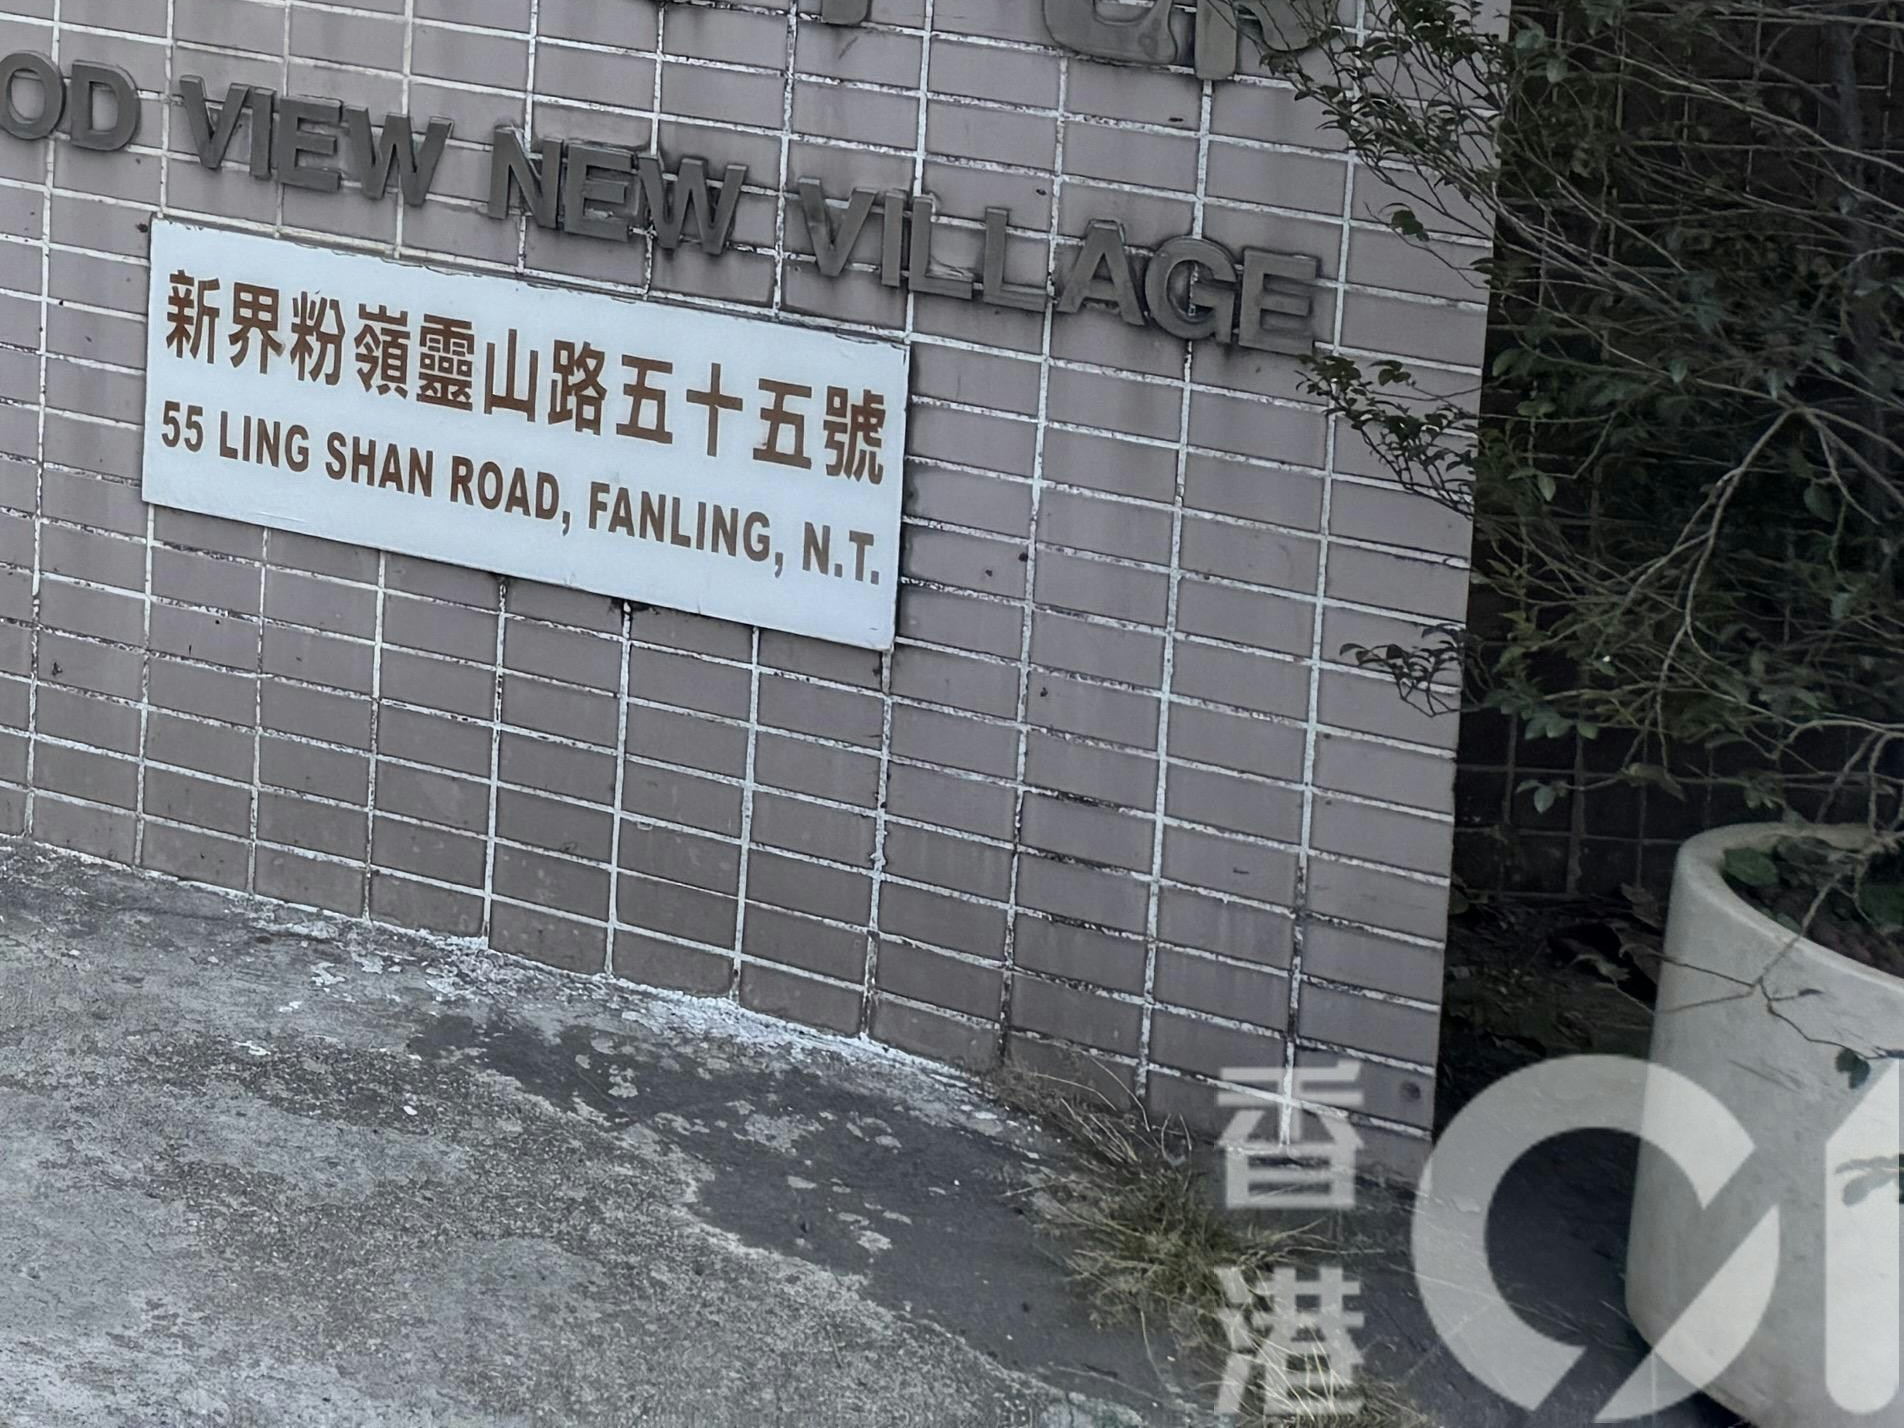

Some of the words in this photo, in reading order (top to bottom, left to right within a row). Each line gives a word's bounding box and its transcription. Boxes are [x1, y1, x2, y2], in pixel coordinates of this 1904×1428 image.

[180, 73, 454, 207] VIEW
[488, 122, 749, 256] NEW
[795, 176, 1323, 358] VILLAGE
[166, 269, 887, 485] 新界粉嶺靈山路五十五號
[161, 400, 205, 453] 55
[218, 408, 311, 475] LING
[325, 431, 435, 498] SHAN
[450, 454, 572, 536] ROAD,
[590, 481, 785, 578] FANLING,
[803, 521, 880, 586] N.T.
